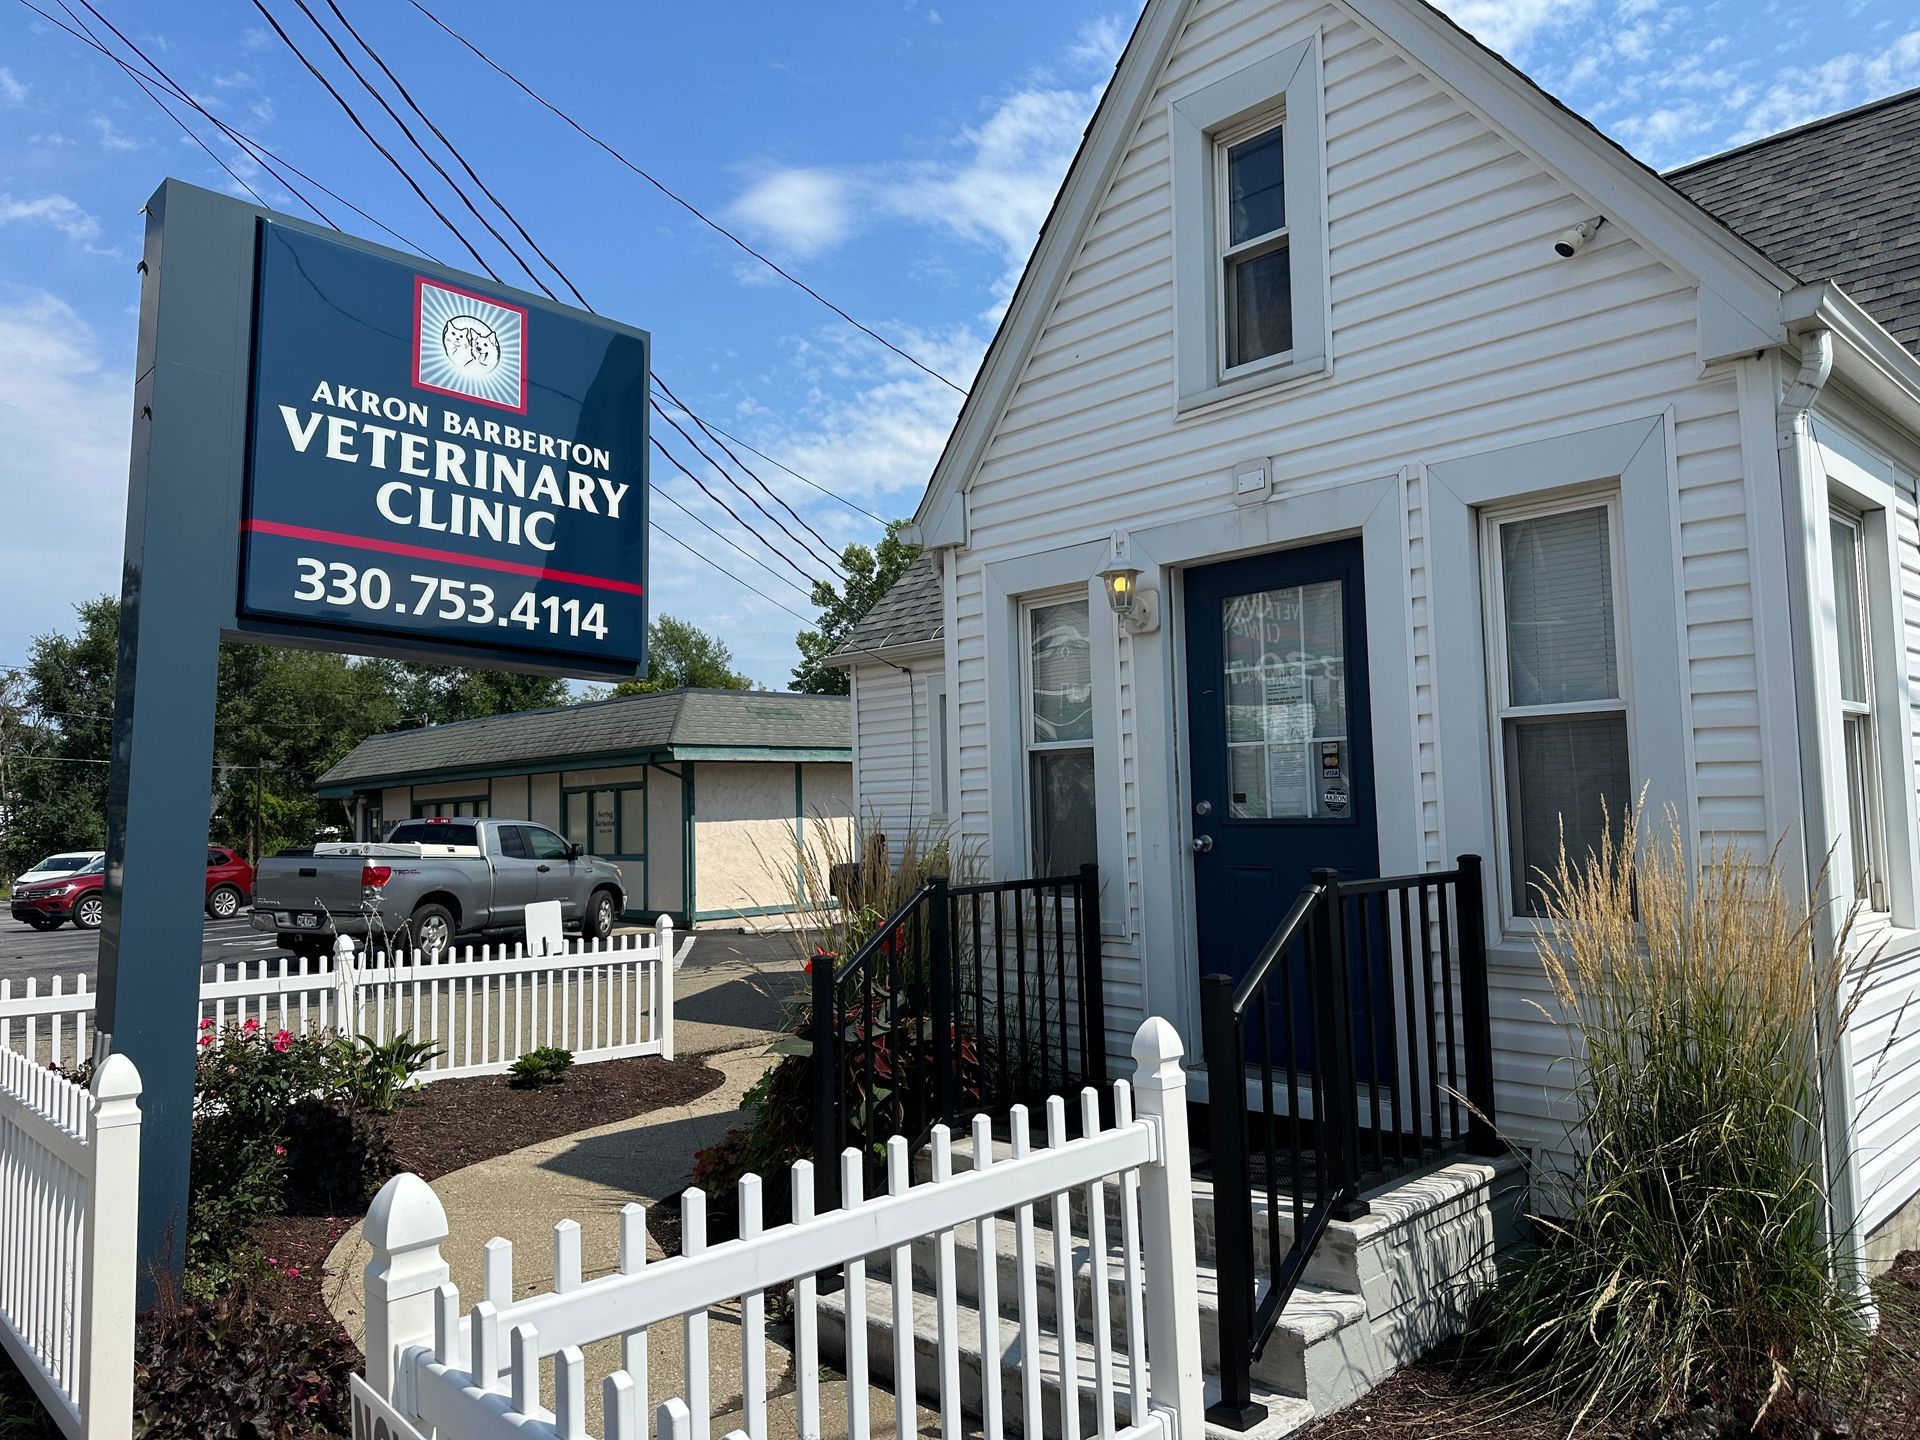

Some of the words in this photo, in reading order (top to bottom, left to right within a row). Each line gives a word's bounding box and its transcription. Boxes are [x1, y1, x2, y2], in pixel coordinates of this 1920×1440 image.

[278, 404, 630, 519] VETERINARY
[311, 380, 428, 428] AKRON
[443, 410, 610, 471] BARBERTON
[375, 481, 556, 551] CLINIC
[294, 557, 608, 640] 330.753.4114
[1325, 794, 1347, 802] AKRON
